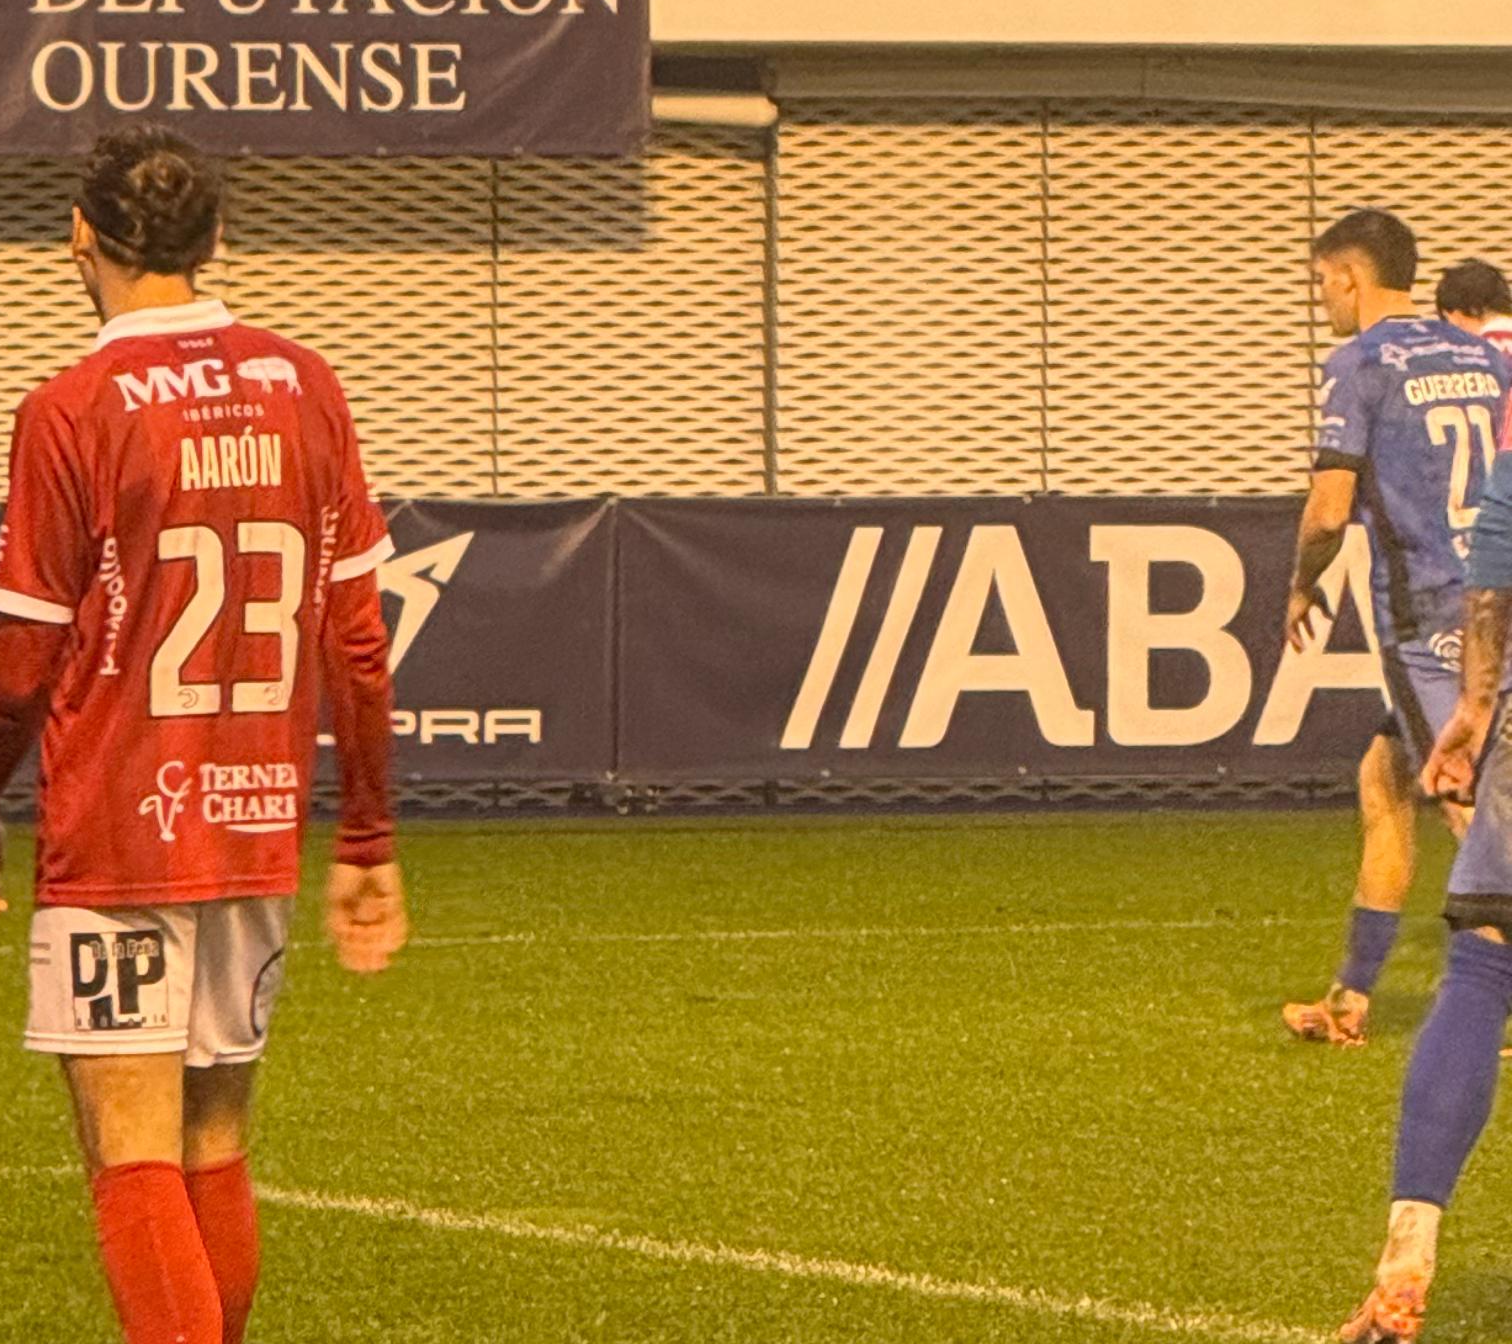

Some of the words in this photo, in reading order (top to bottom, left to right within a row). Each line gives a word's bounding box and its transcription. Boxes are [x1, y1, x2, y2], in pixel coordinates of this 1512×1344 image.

[30, 40, 468, 113] OURENSE
[113, 358, 232, 412] MMG
[183, 403, 265, 422] IBÉRICOS
[180, 425, 282, 491] AARÓN
[149, 520, 307, 718] 23
